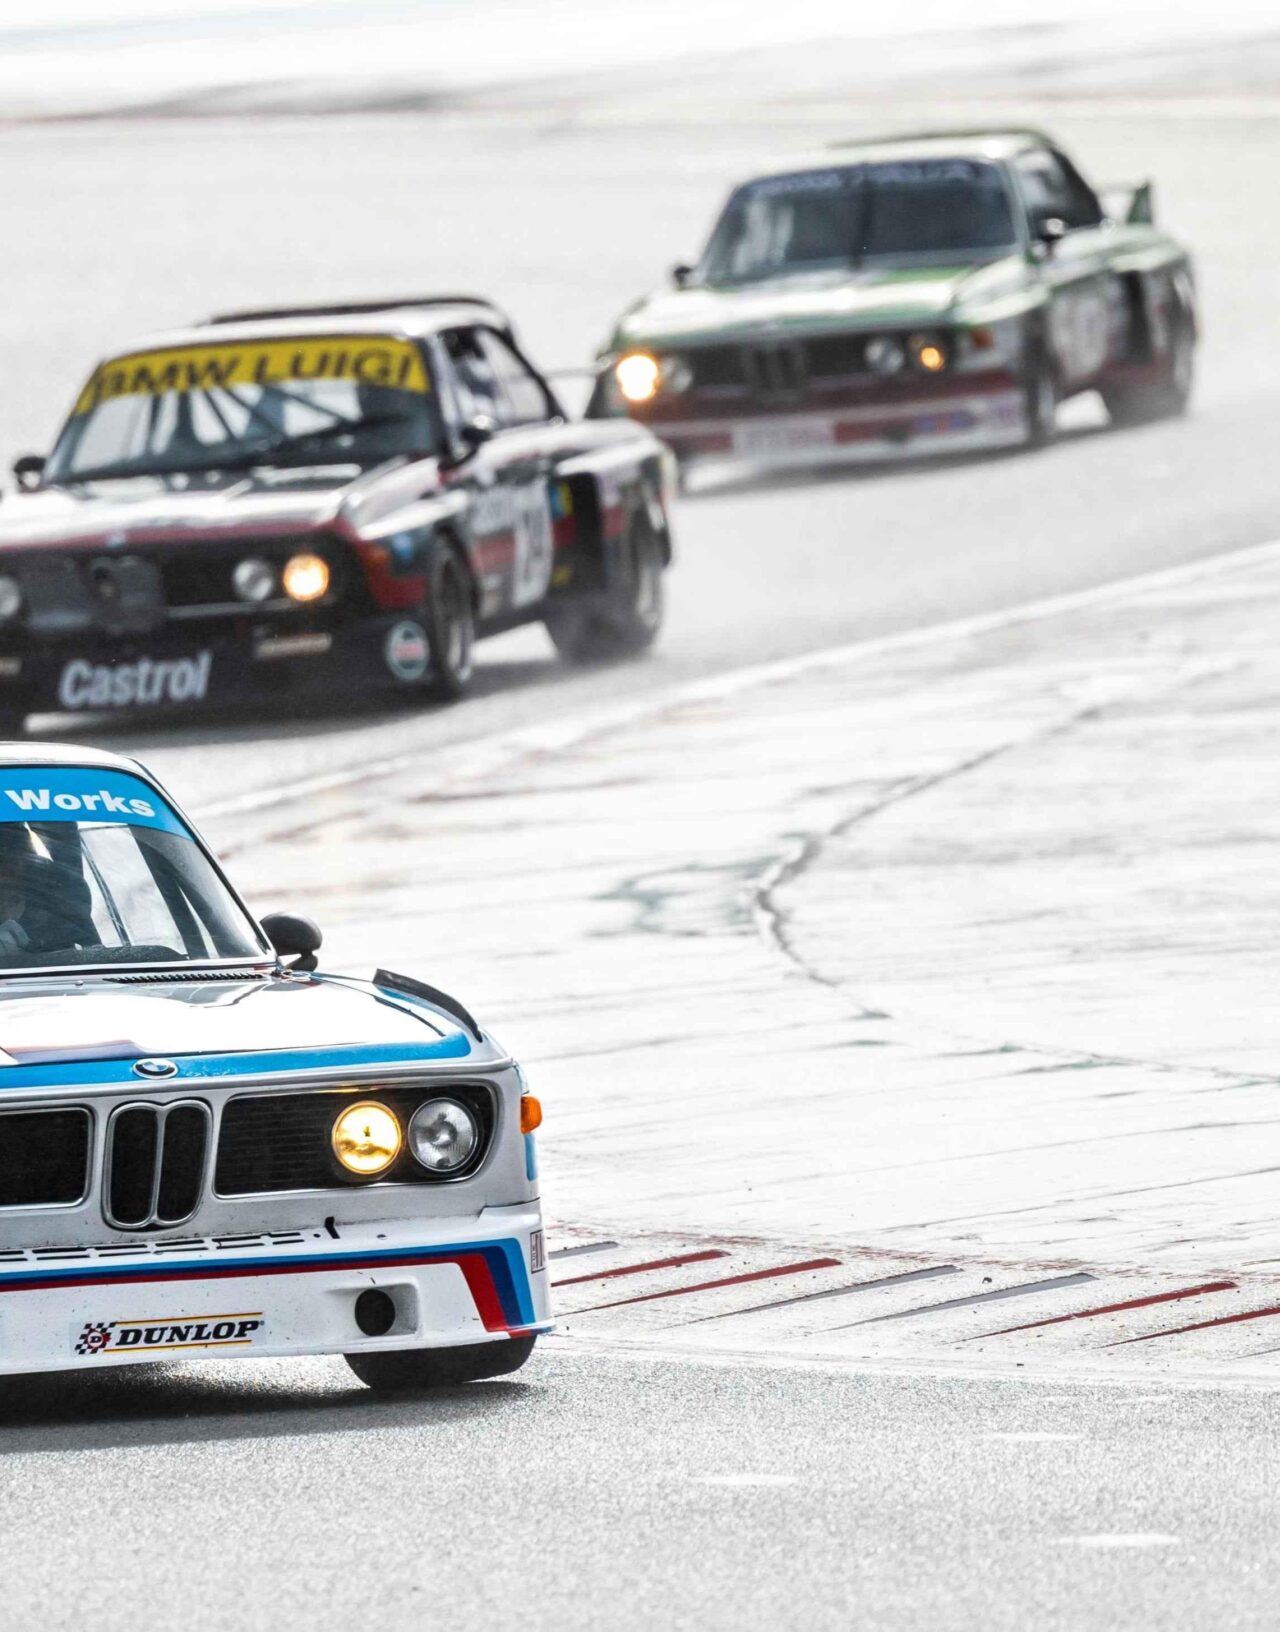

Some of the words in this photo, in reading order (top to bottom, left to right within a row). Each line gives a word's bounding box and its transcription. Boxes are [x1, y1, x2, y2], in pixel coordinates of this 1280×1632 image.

[94, 357, 240, 398] BMW
[253, 348, 411, 384] LUIGI
[59, 650, 213, 707] Castrol
[4, 788, 157, 818] Works
[115, 1320, 260, 1347] DUNLOP
